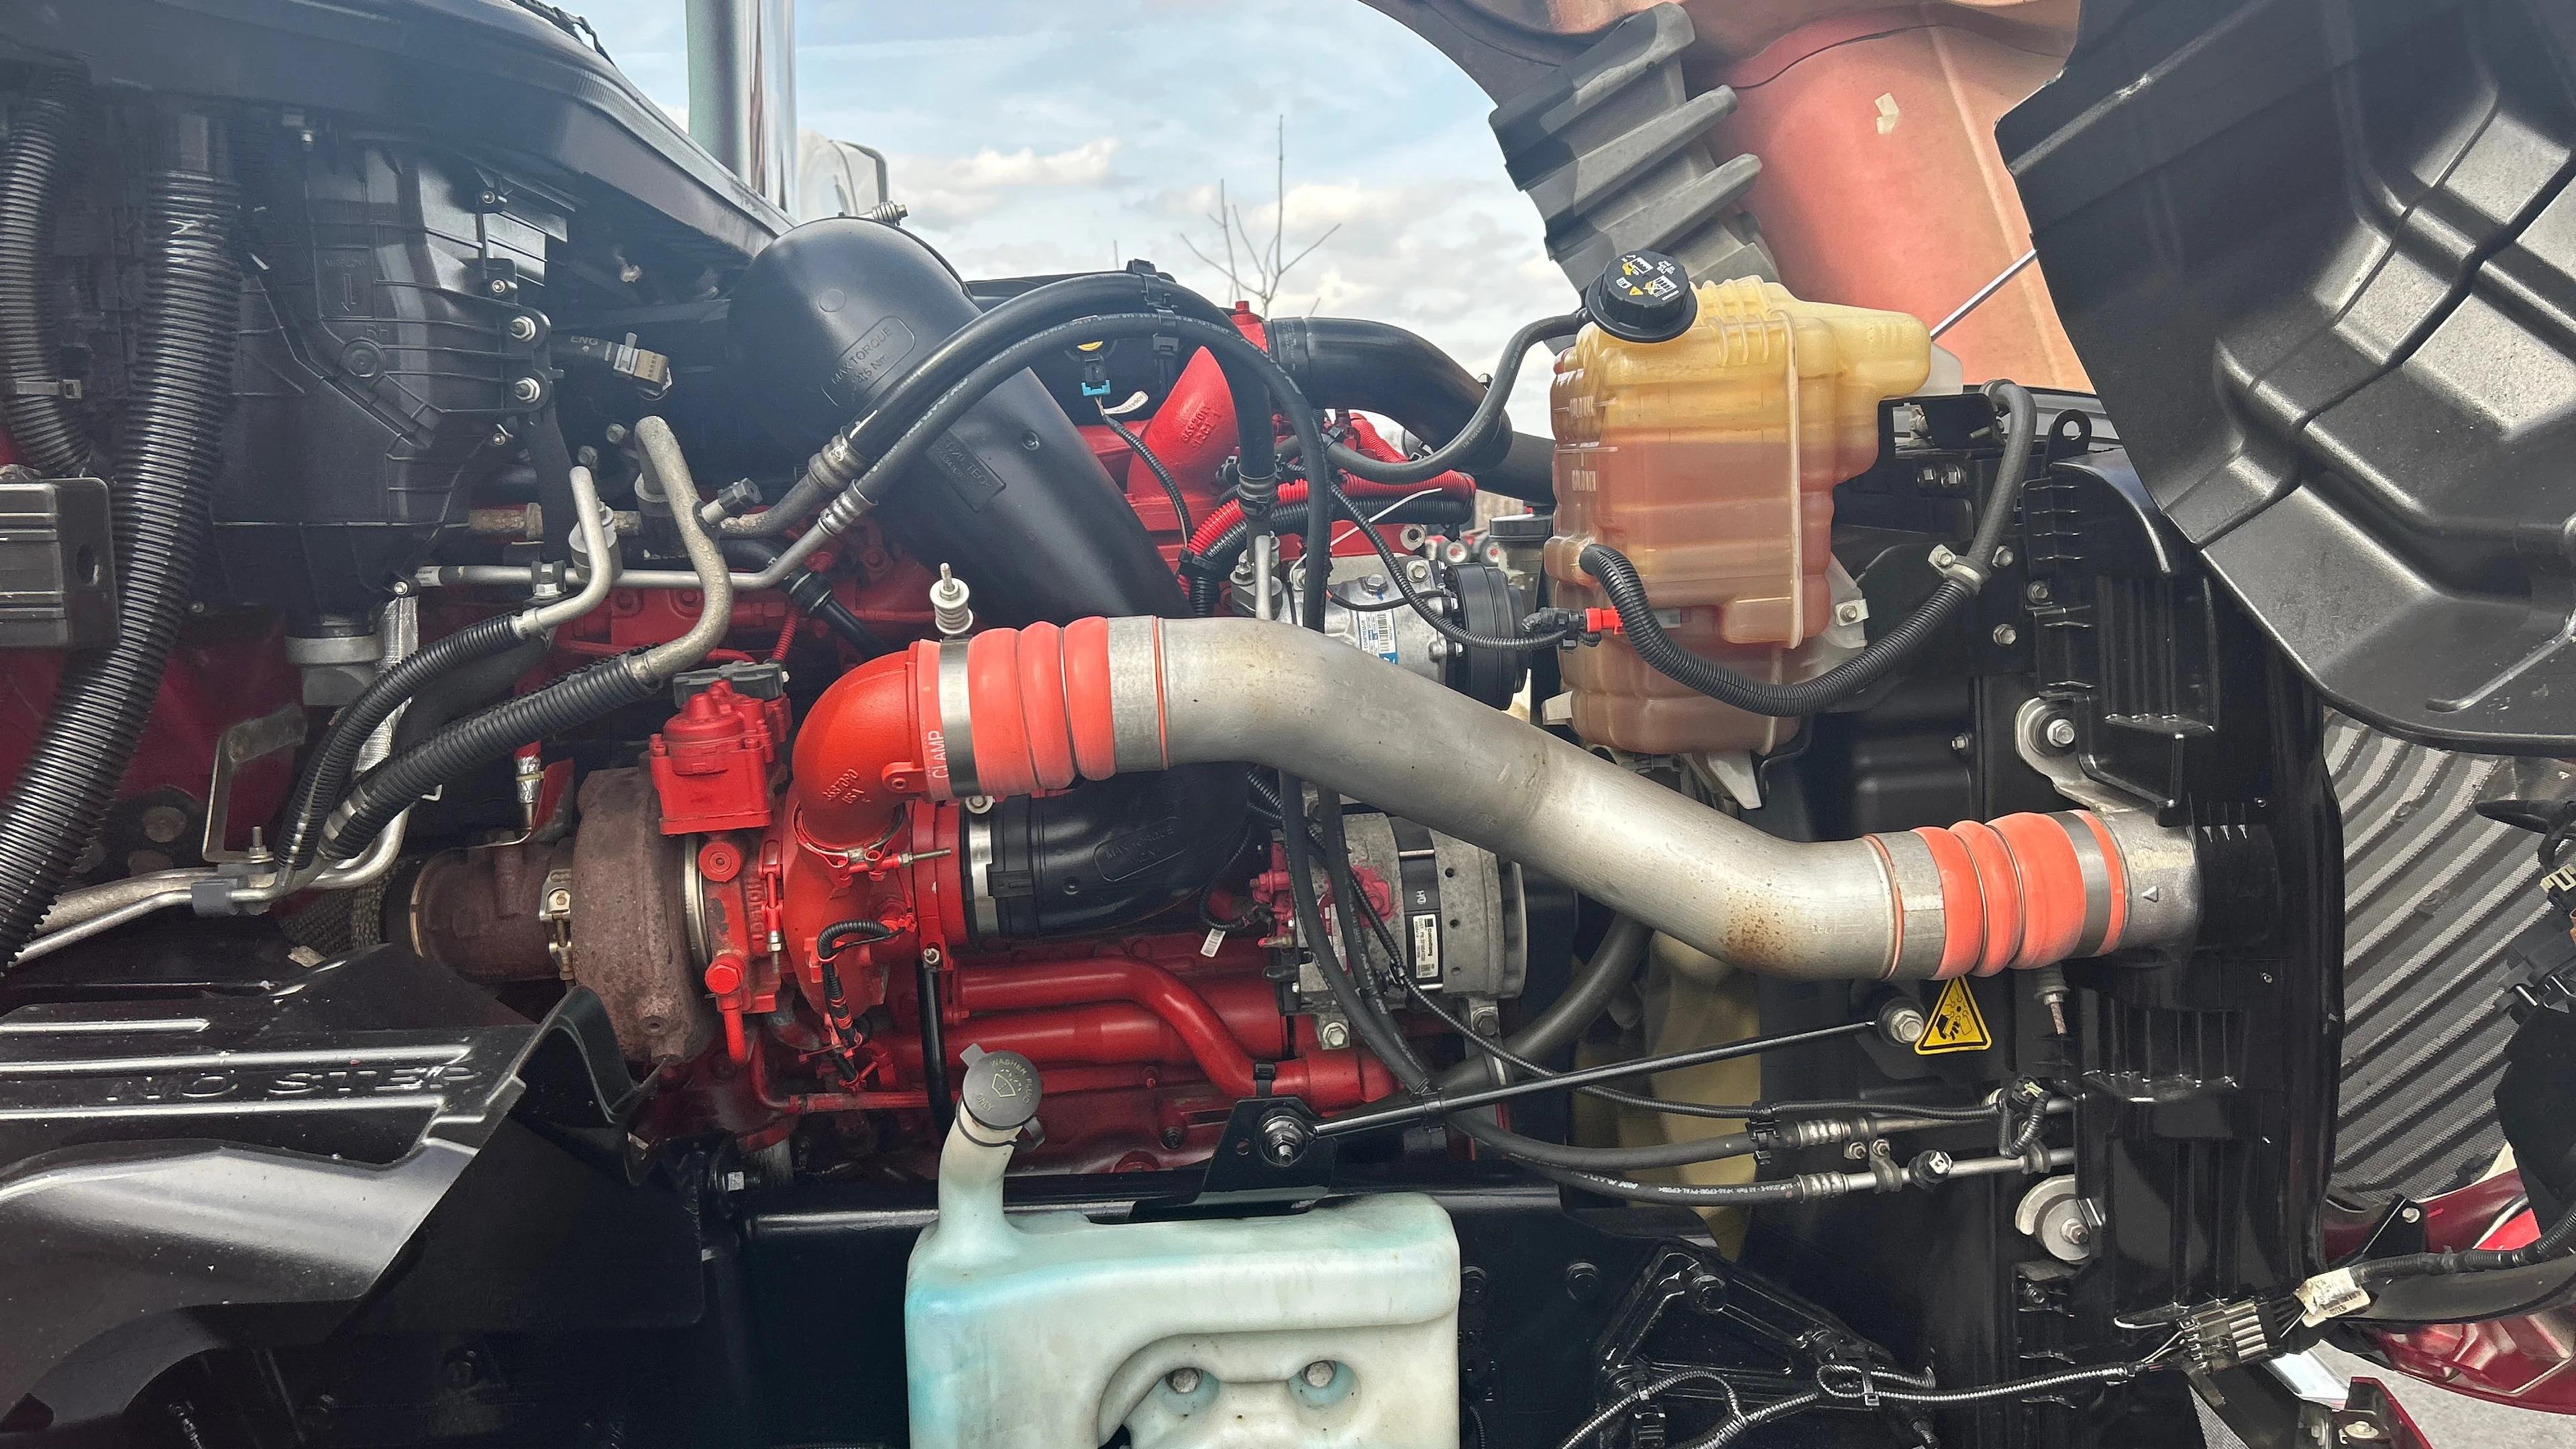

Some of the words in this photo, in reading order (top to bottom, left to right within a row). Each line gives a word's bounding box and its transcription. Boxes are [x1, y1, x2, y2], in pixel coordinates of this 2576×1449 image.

[570, 335, 599, 345] ENG
[849, 327, 893, 365] TORQUE
[106, 1071, 239, 1102] NO
[268, 1066, 482, 1094] STEP
[989, 1058, 1028, 1075] WASHER
[1022, 1078, 1034, 1104] FLUID
[975, 1092, 994, 1112] ONLY
